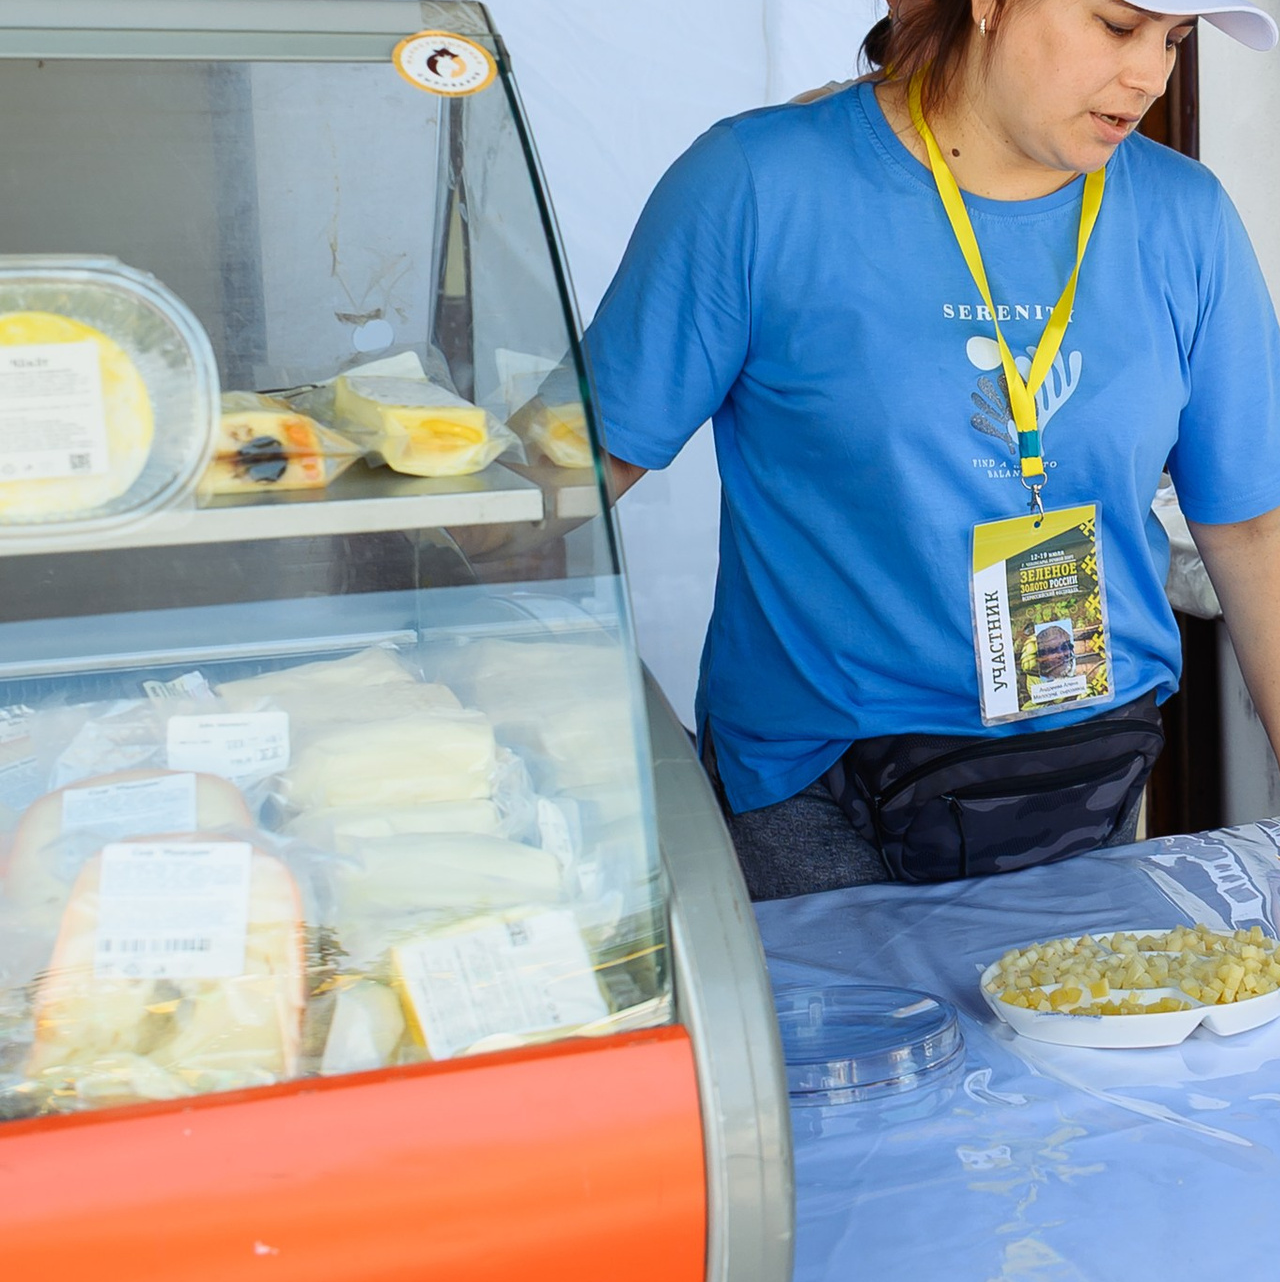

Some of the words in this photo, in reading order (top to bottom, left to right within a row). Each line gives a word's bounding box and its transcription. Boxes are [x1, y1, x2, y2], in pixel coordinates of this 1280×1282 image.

[972, 458, 996, 468] FIND
[987, 469, 1021, 479] BALAN
[1020, 562, 1078, 584] ЗЕЛЕНОЕ
[1020, 580, 1048, 594] ЗОЛОТО
[1049, 574, 1078, 589] РОССИИ
[984, 590, 1008, 693] УЧАСТНИК
